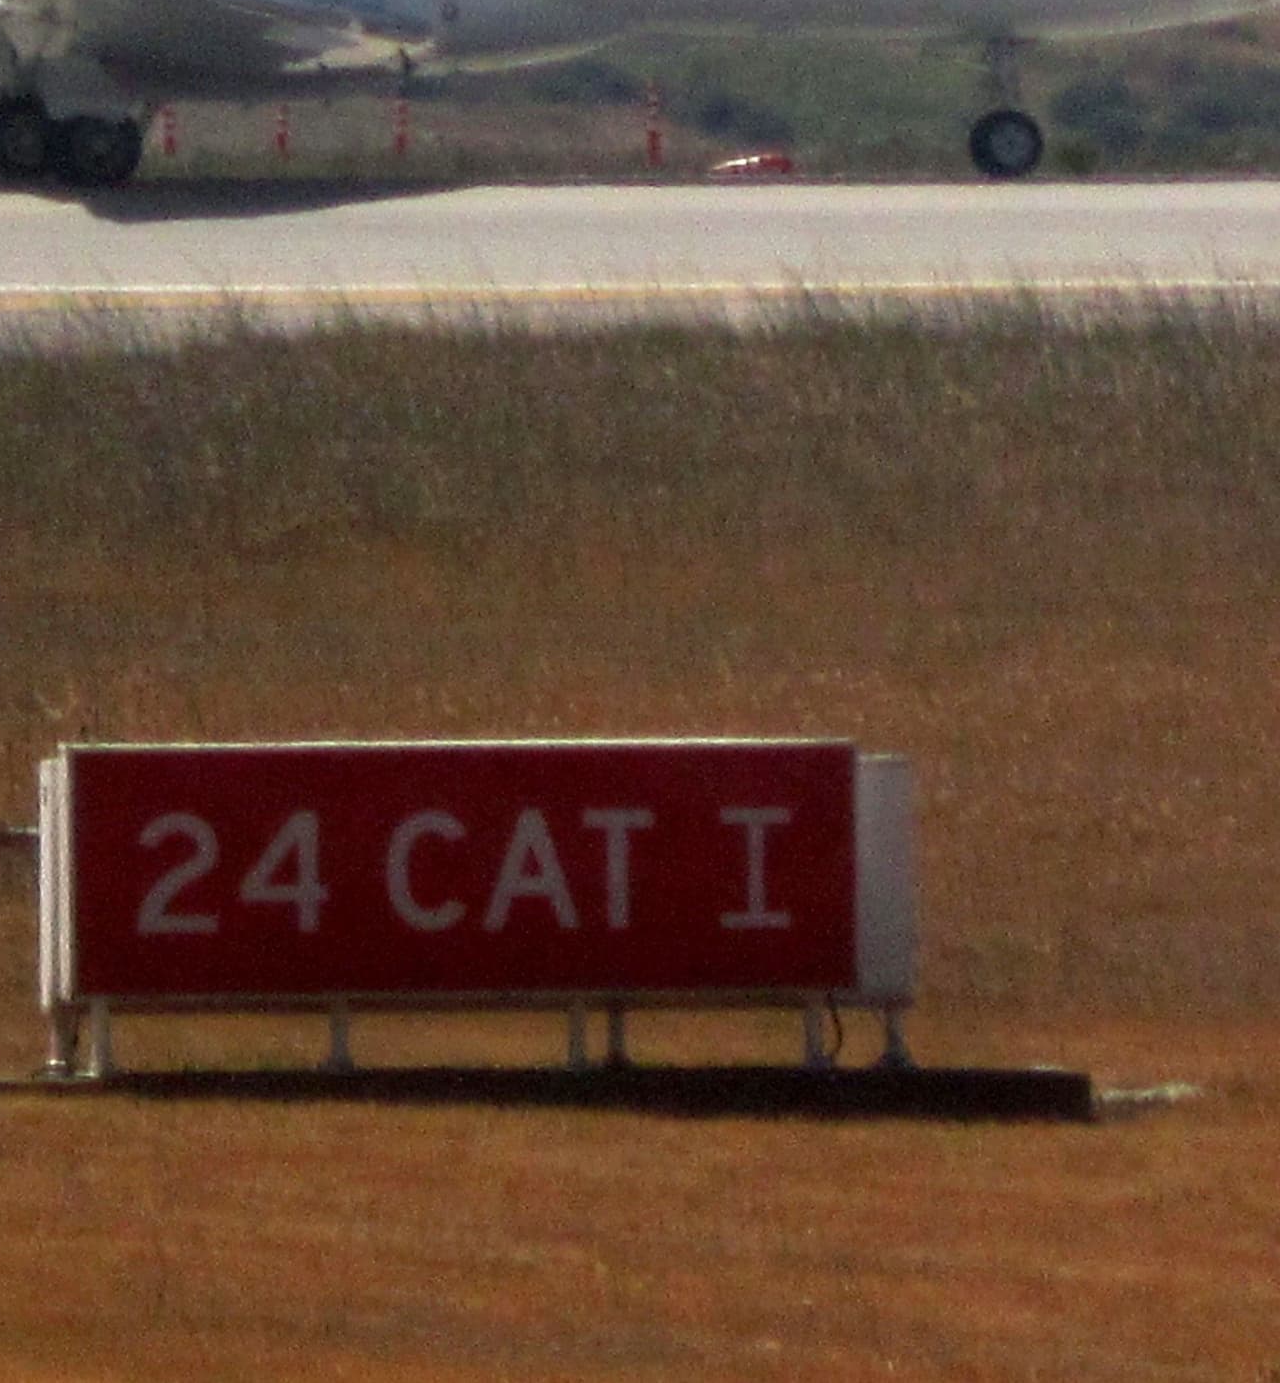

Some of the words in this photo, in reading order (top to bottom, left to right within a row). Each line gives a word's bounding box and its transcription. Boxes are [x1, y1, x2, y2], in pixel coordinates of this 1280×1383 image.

[136, 809, 329, 936] 24
[384, 808, 656, 935] CAT
[719, 807, 793, 931] I
